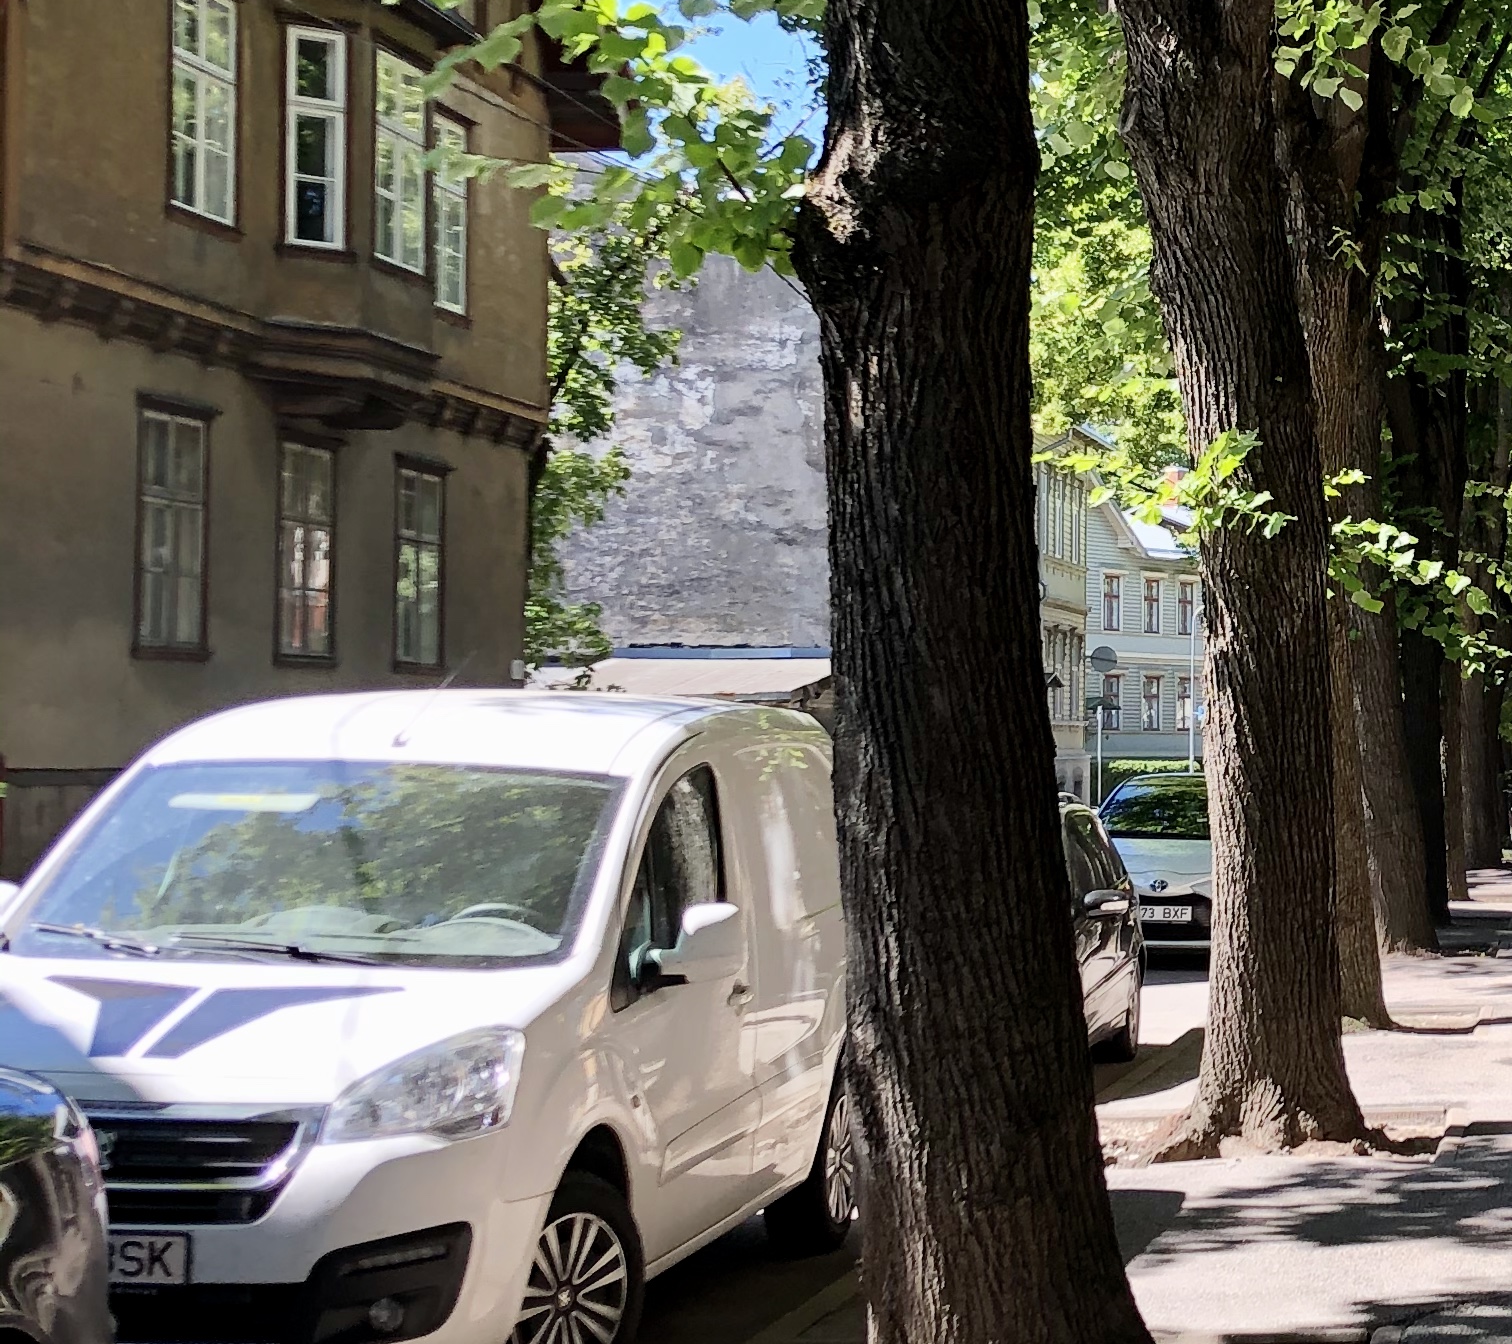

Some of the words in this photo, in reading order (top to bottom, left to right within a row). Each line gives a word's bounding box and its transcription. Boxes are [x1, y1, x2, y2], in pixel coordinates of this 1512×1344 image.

[1140, 907, 1155, 919] 73
[1162, 907, 1189, 919] BXF
[108, 1240, 173, 1277] SK
